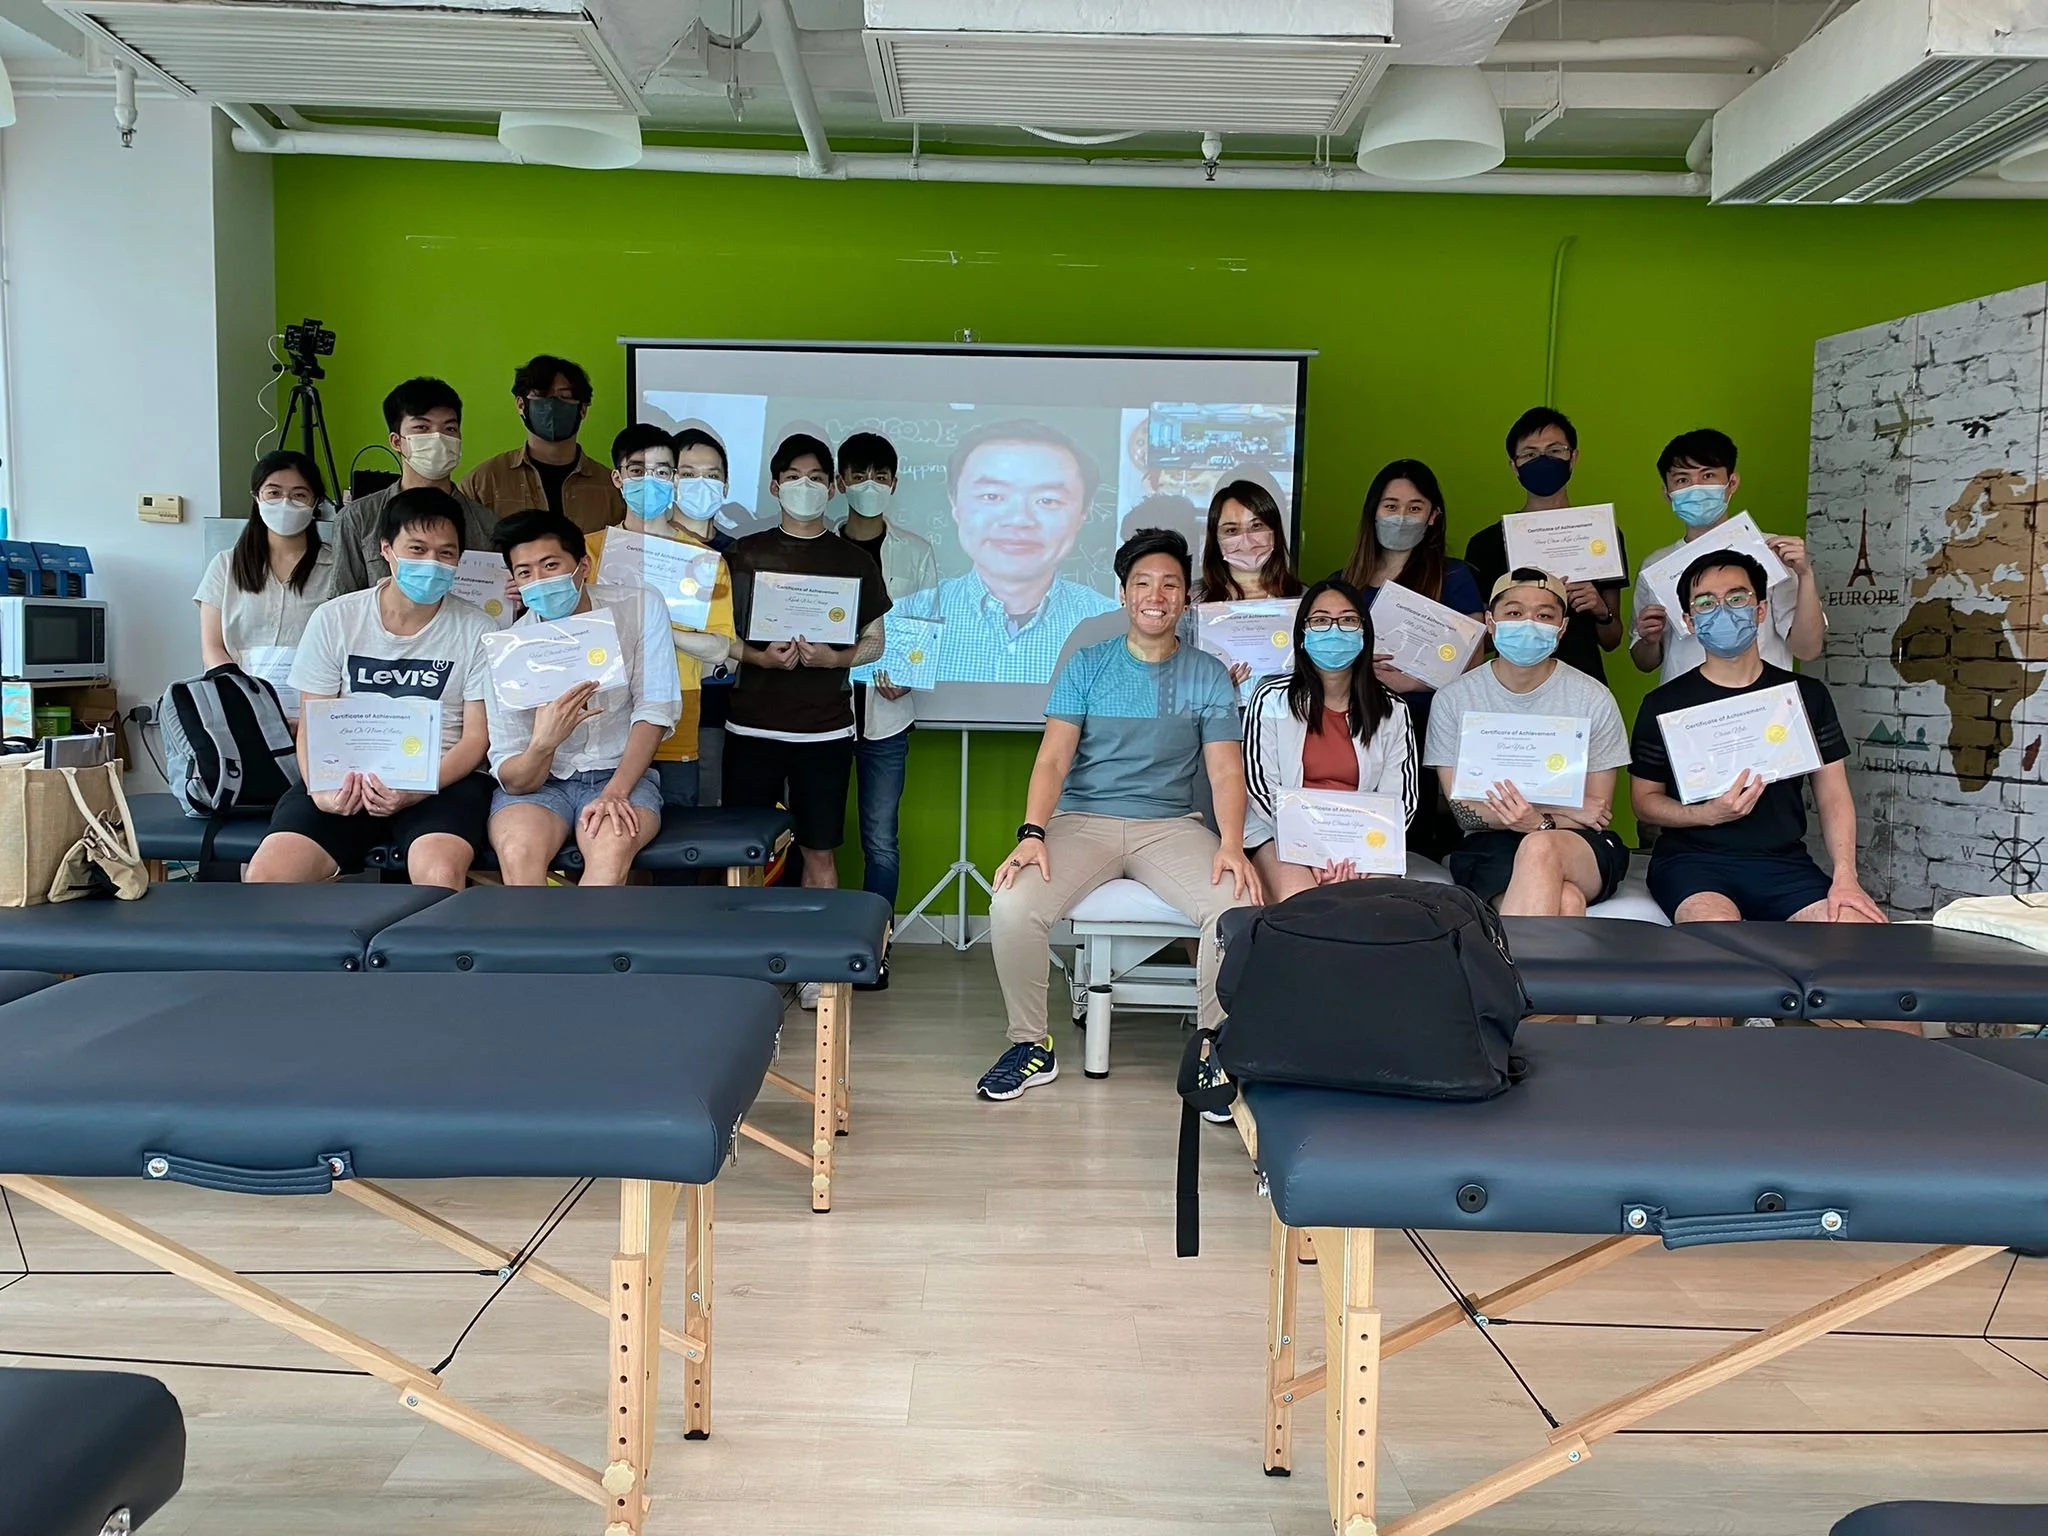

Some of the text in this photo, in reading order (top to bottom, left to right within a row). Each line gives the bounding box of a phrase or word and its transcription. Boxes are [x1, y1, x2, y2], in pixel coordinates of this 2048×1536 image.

[1827, 588, 1900, 607] EUROPE
[330, 713, 364, 721] Certificate
[372, 713, 411, 721] Achievement
[1684, 716, 1719, 731] Certificate
[1726, 705, 1767, 721] Achievement
[1860, 756, 1934, 778] AFRICA
[1961, 844, 1976, 861] W
